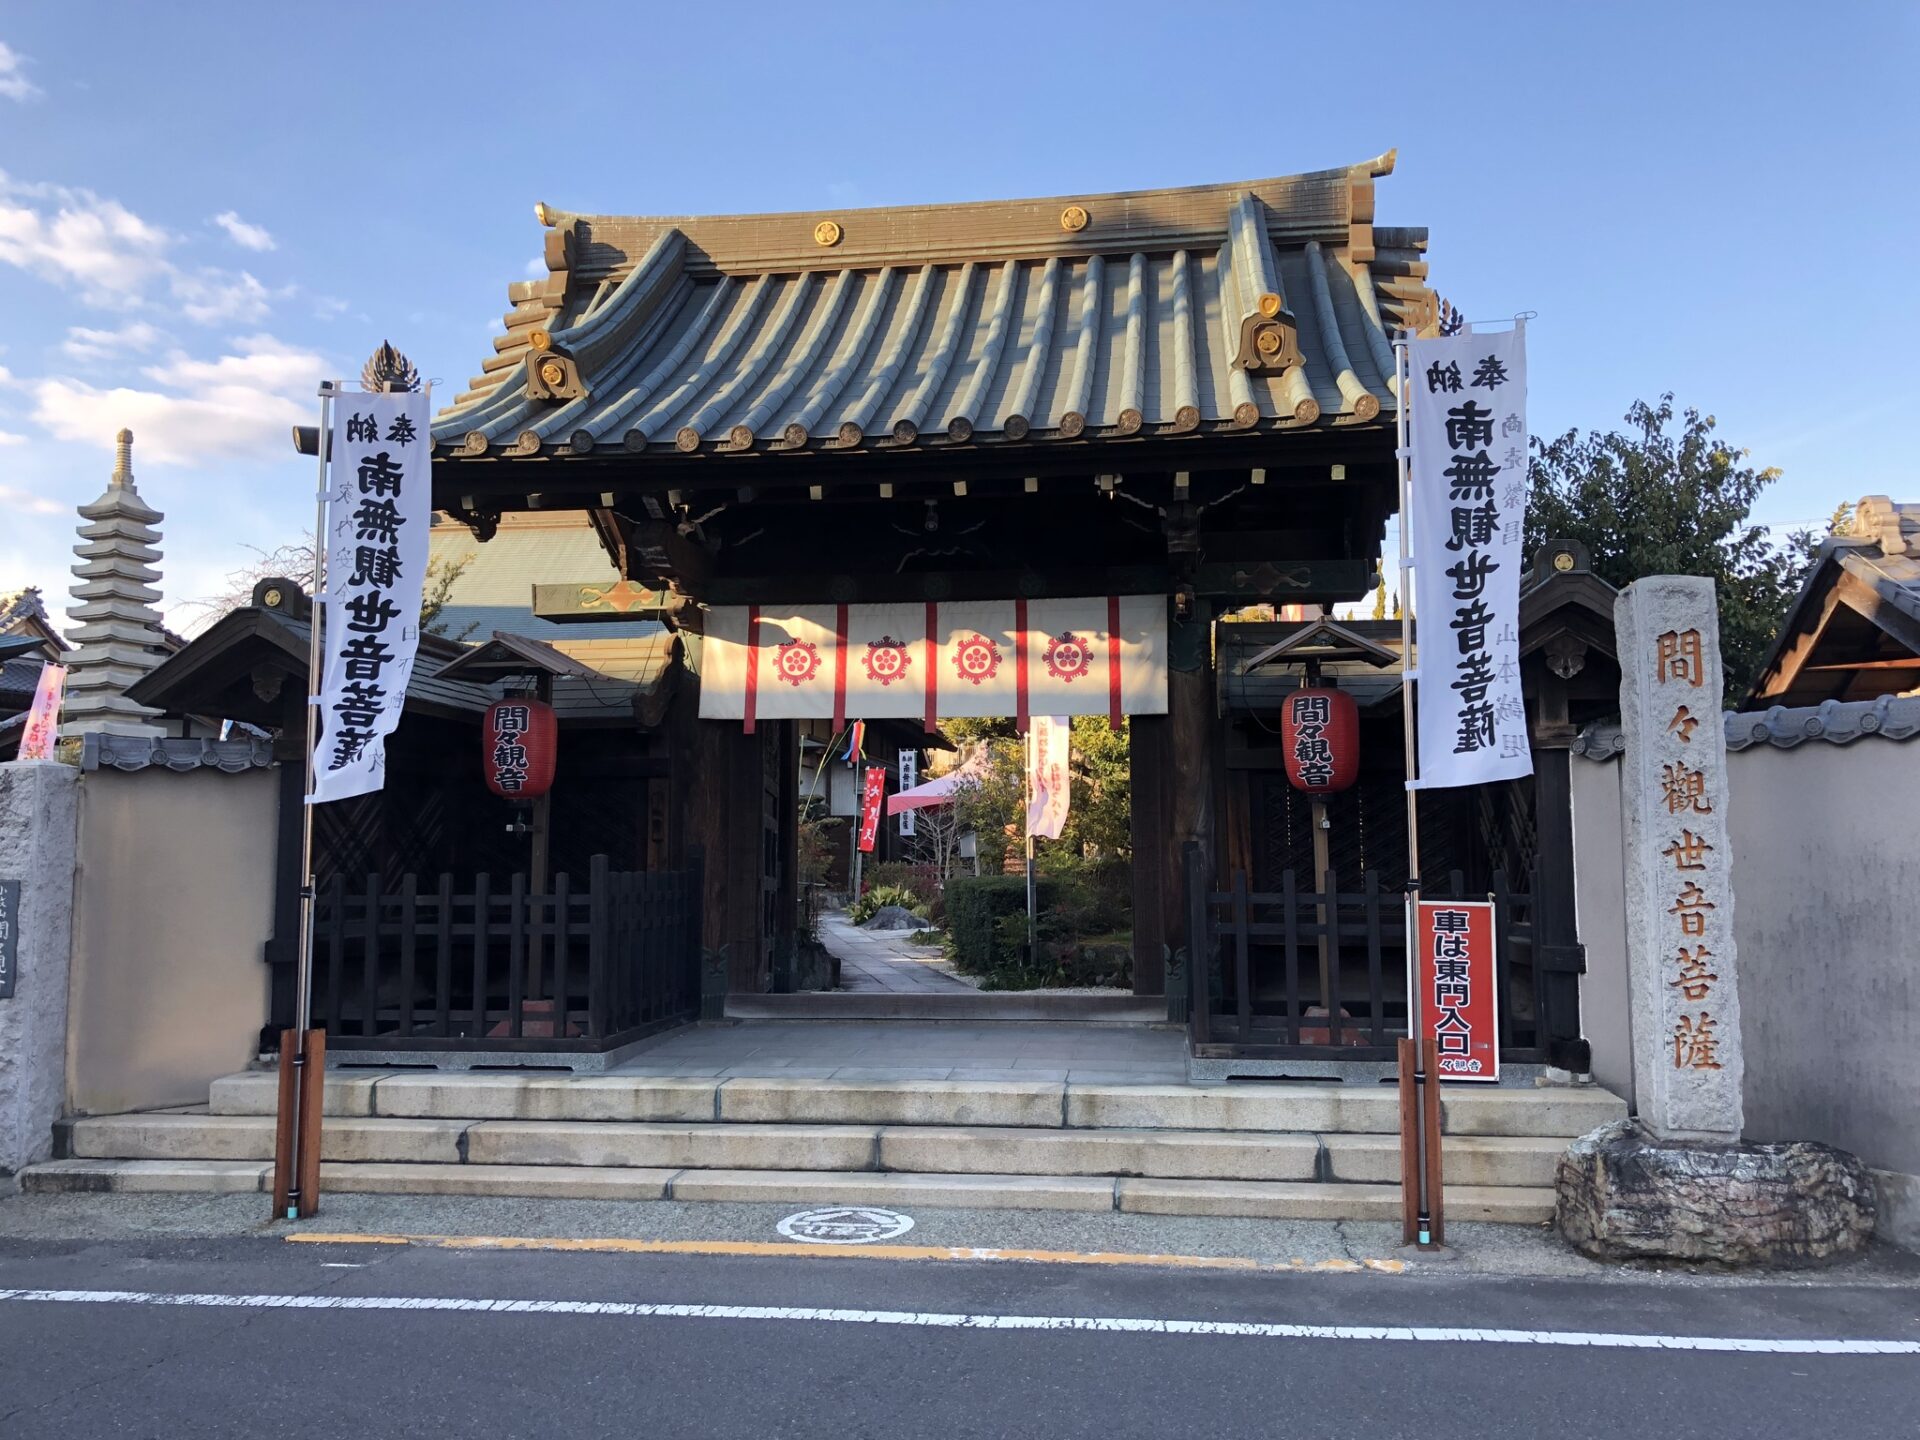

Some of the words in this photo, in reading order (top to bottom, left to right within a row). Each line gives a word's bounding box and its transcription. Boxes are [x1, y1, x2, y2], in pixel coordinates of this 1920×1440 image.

[492, 705, 531, 793] 間々観音
[1291, 695, 1334, 786] 間々観音
[1432, 908, 1472, 1056] 車は東門入口
[1439, 1058, 1482, 1074] 々観音
